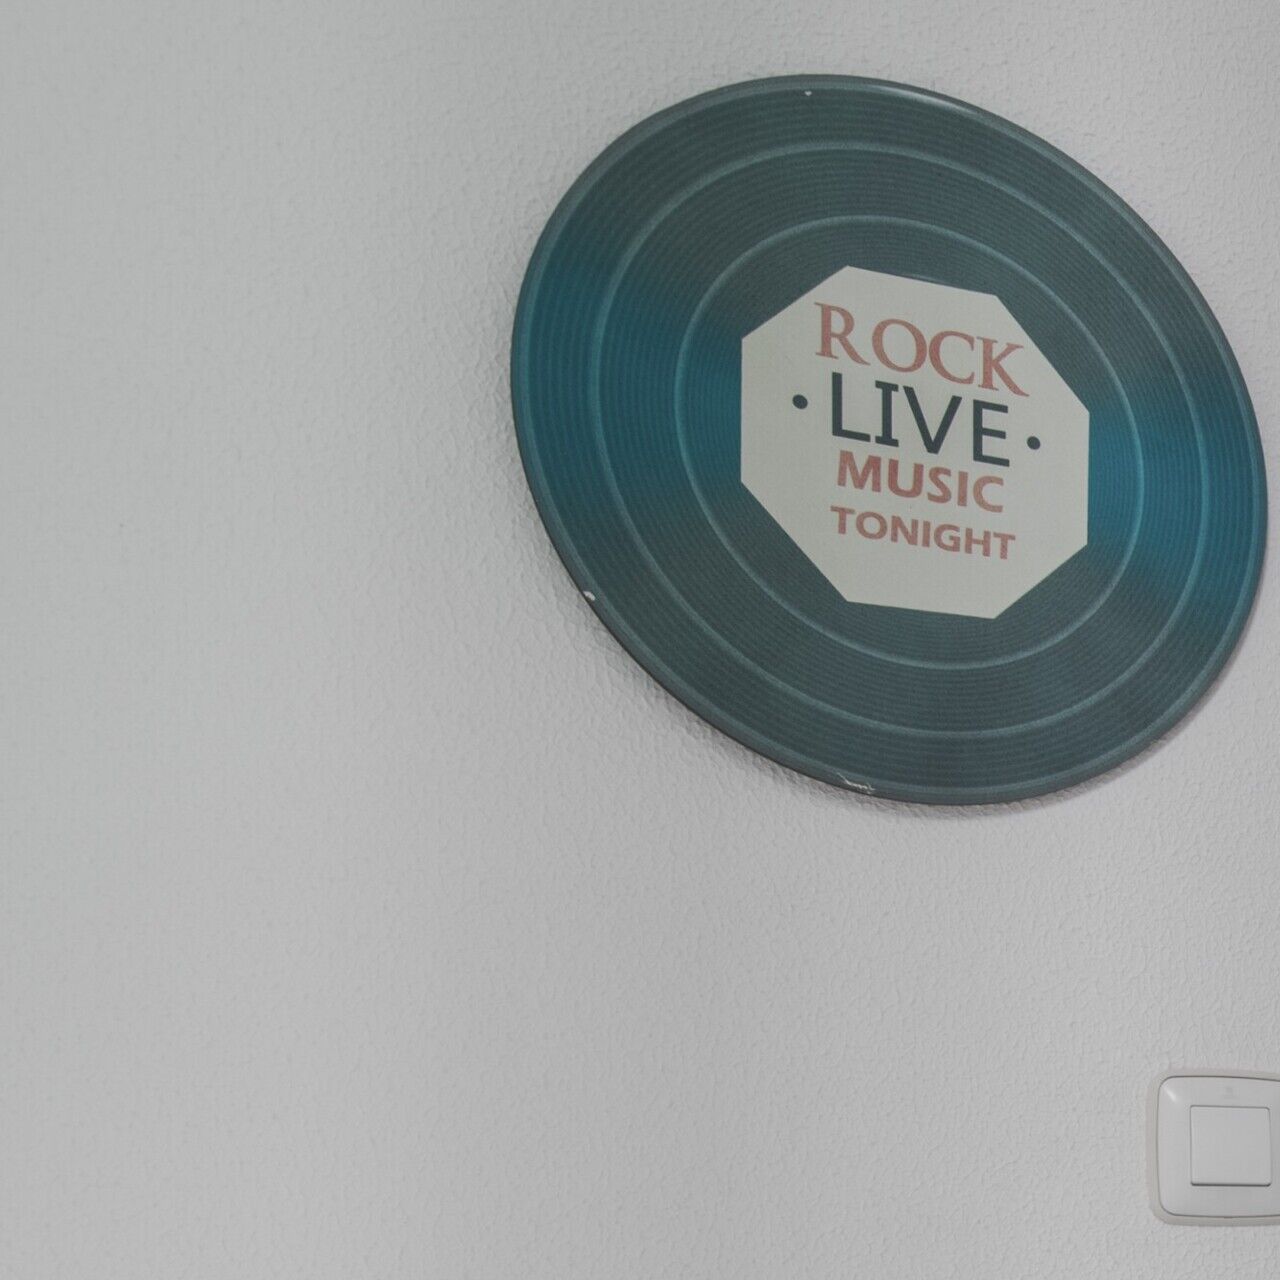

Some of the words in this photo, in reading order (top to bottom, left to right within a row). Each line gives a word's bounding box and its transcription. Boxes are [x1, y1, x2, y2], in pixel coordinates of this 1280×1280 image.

[814, 302, 1029, 397] ROCK
[831, 371, 1010, 467] LIVE
[836, 450, 1004, 513] MUSIC
[830, 505, 1016, 560] TONIGHT
